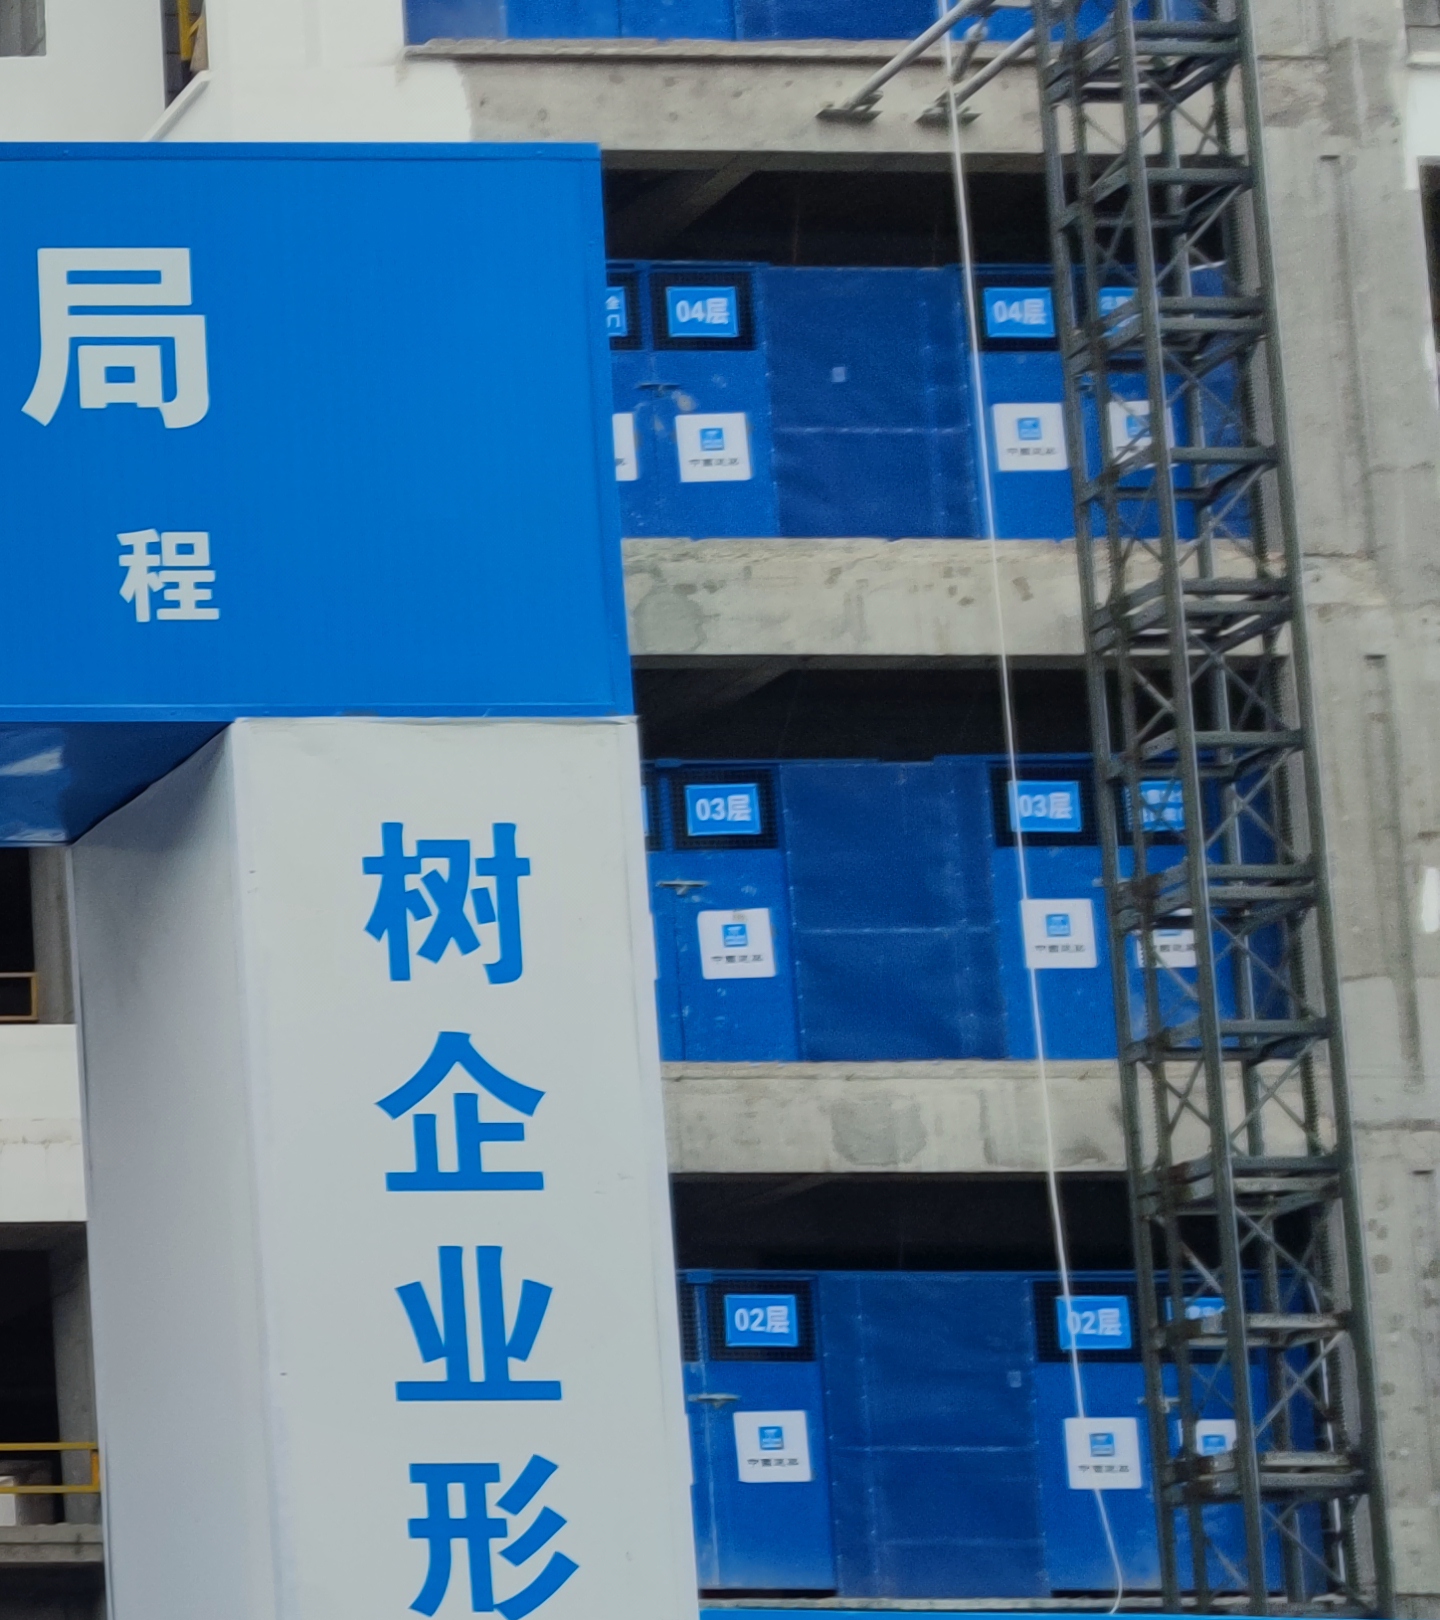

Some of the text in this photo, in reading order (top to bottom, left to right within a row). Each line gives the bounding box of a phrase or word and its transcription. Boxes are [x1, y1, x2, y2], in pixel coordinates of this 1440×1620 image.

[675, 297, 730, 325] 04层
[992, 297, 1047, 325] 04层
[695, 794, 752, 822] 03层
[1019, 791, 1073, 820] 03层
[733, 1306, 791, 1335] 02层
[1067, 1307, 1123, 1337] 02层
